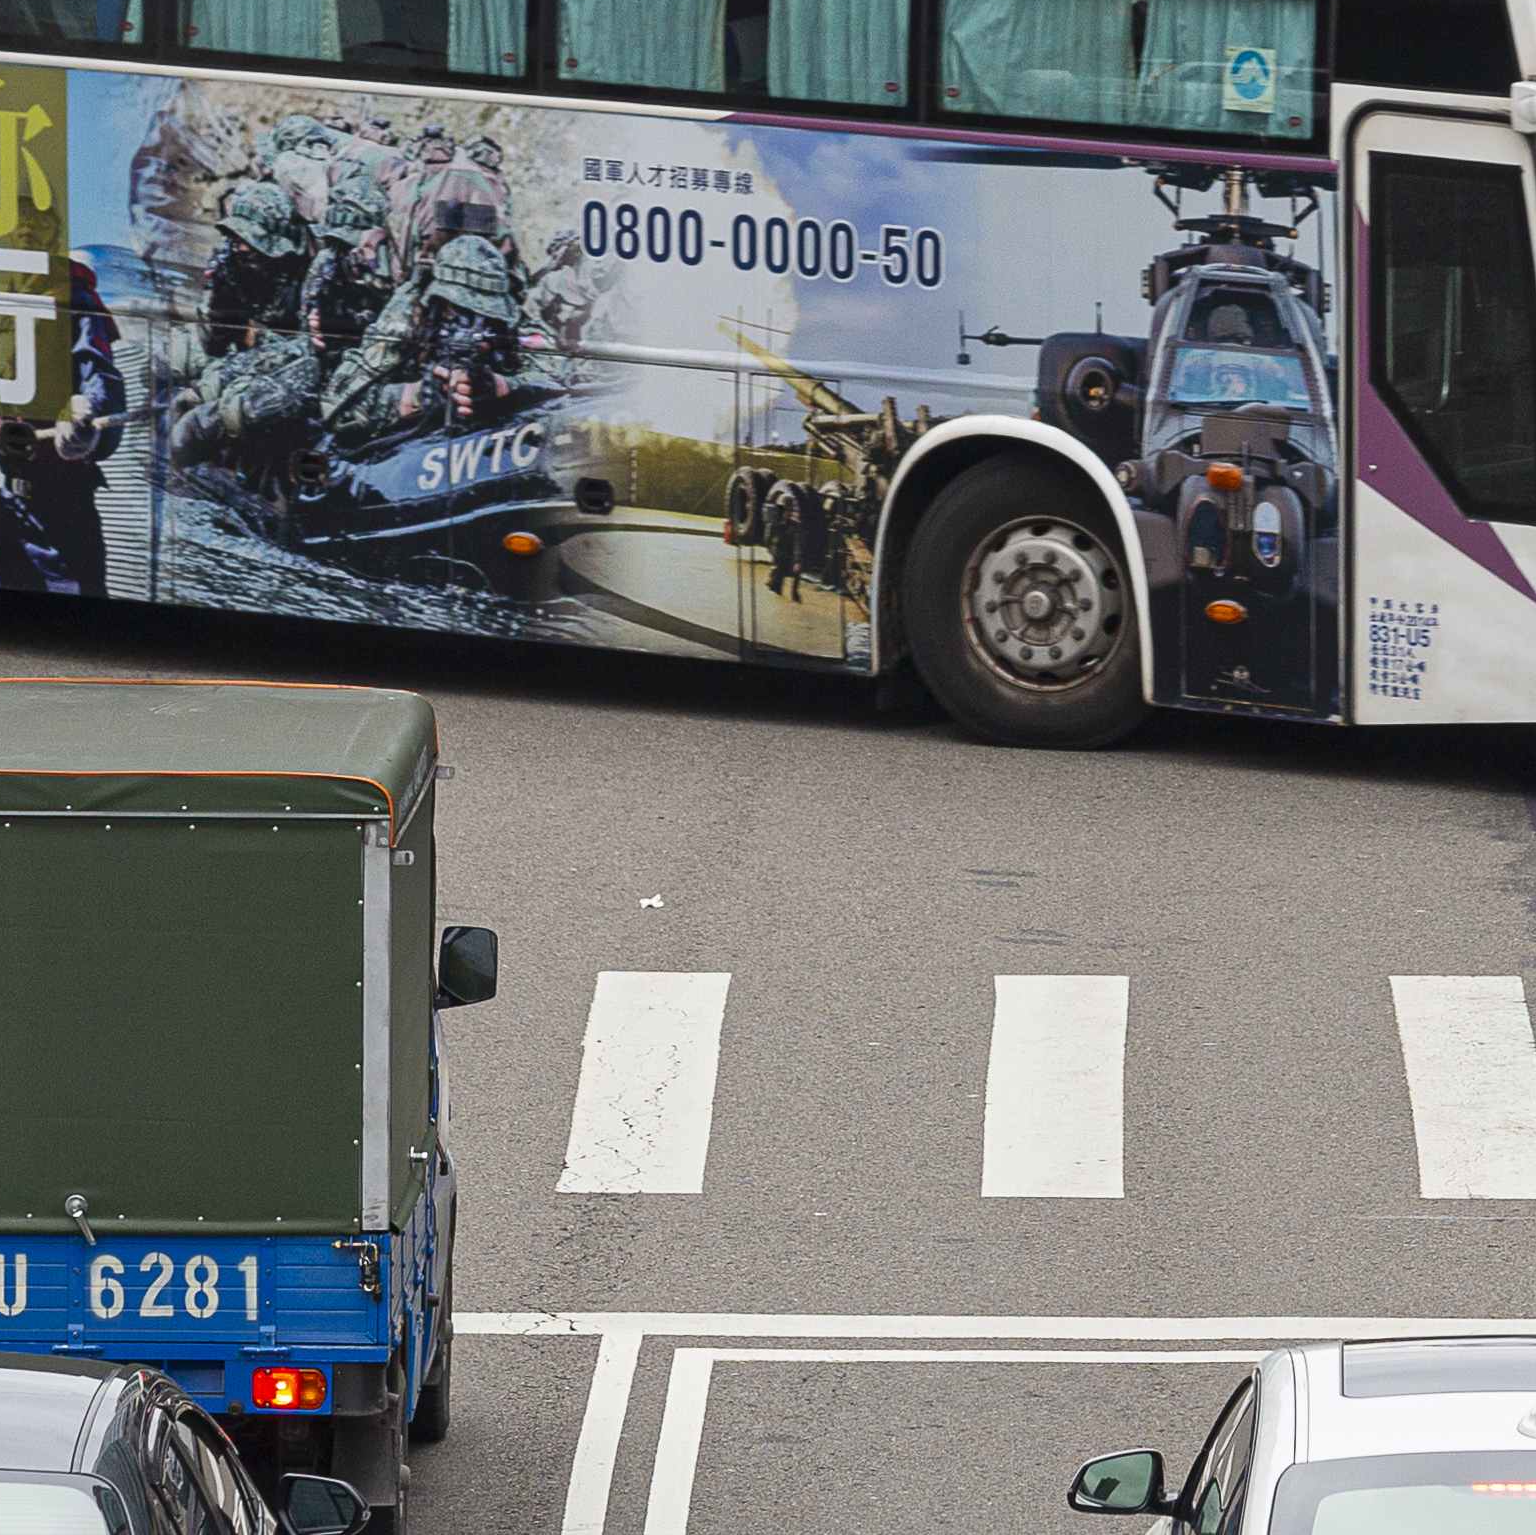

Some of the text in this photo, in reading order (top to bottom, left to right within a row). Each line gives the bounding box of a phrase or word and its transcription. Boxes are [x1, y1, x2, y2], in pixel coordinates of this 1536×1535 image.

[583, 157, 755, 195] 國軍人才招募專線
[582, 199, 946, 290] 0800-0000-50
[417, 422, 544, 491] SWTC
[1369, 624, 1432, 648] 831-U5
[89, 1252, 261, 1322] 6281
